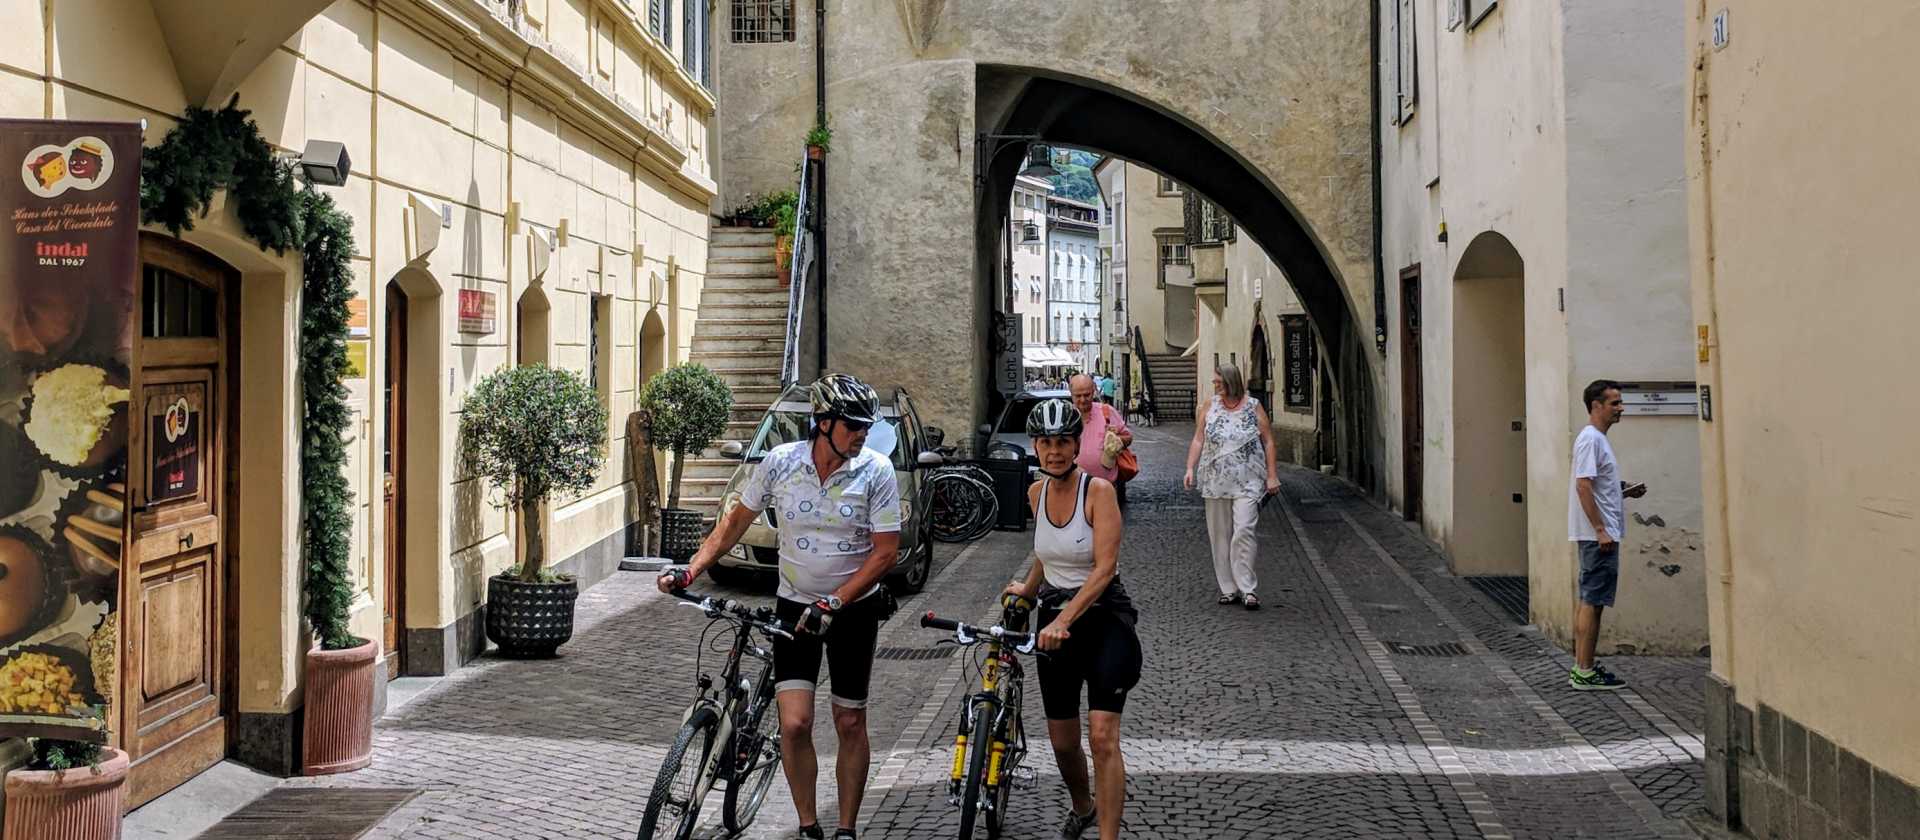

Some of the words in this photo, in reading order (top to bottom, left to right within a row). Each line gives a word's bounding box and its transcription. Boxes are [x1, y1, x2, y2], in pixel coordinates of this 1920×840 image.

[41, 205, 58, 219] der
[15, 222, 41, 234] Casa
[42, 219, 61, 232] del
[36, 241, 88, 257] indal
[39, 257, 58, 266] DAL
[61, 257, 86, 267] 1967
[1004, 357, 1017, 391] Licht
